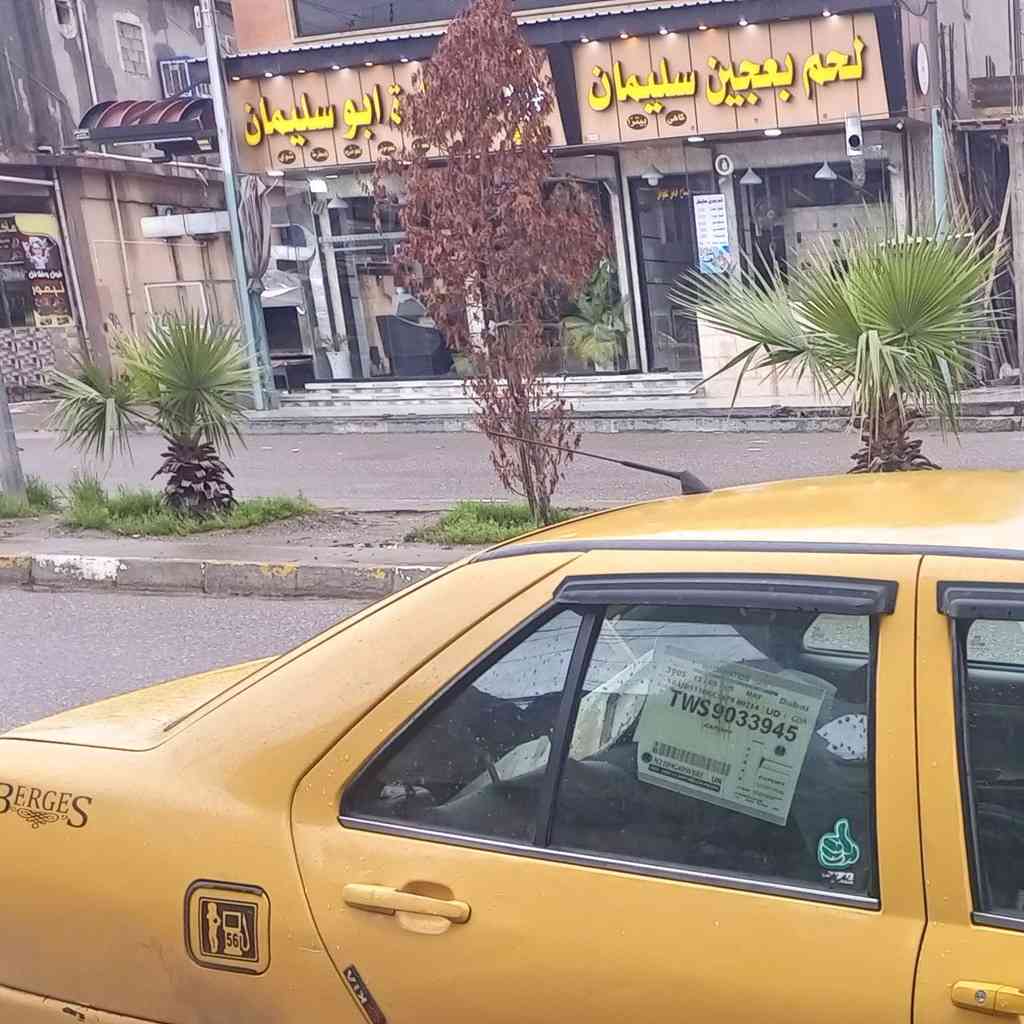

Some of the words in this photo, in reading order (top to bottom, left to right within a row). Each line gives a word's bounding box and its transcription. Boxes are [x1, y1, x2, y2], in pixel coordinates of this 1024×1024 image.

[588, 58, 696, 113] سليمان
[706, 52, 794, 107] بعجين
[803, 35, 866, 98] لحم
[244, 92, 337, 146] سليمان
[344, 84, 383, 140] ابو
[669, 688, 799, 743] TWS9033945
[0, 782, 93, 829] BERGES
